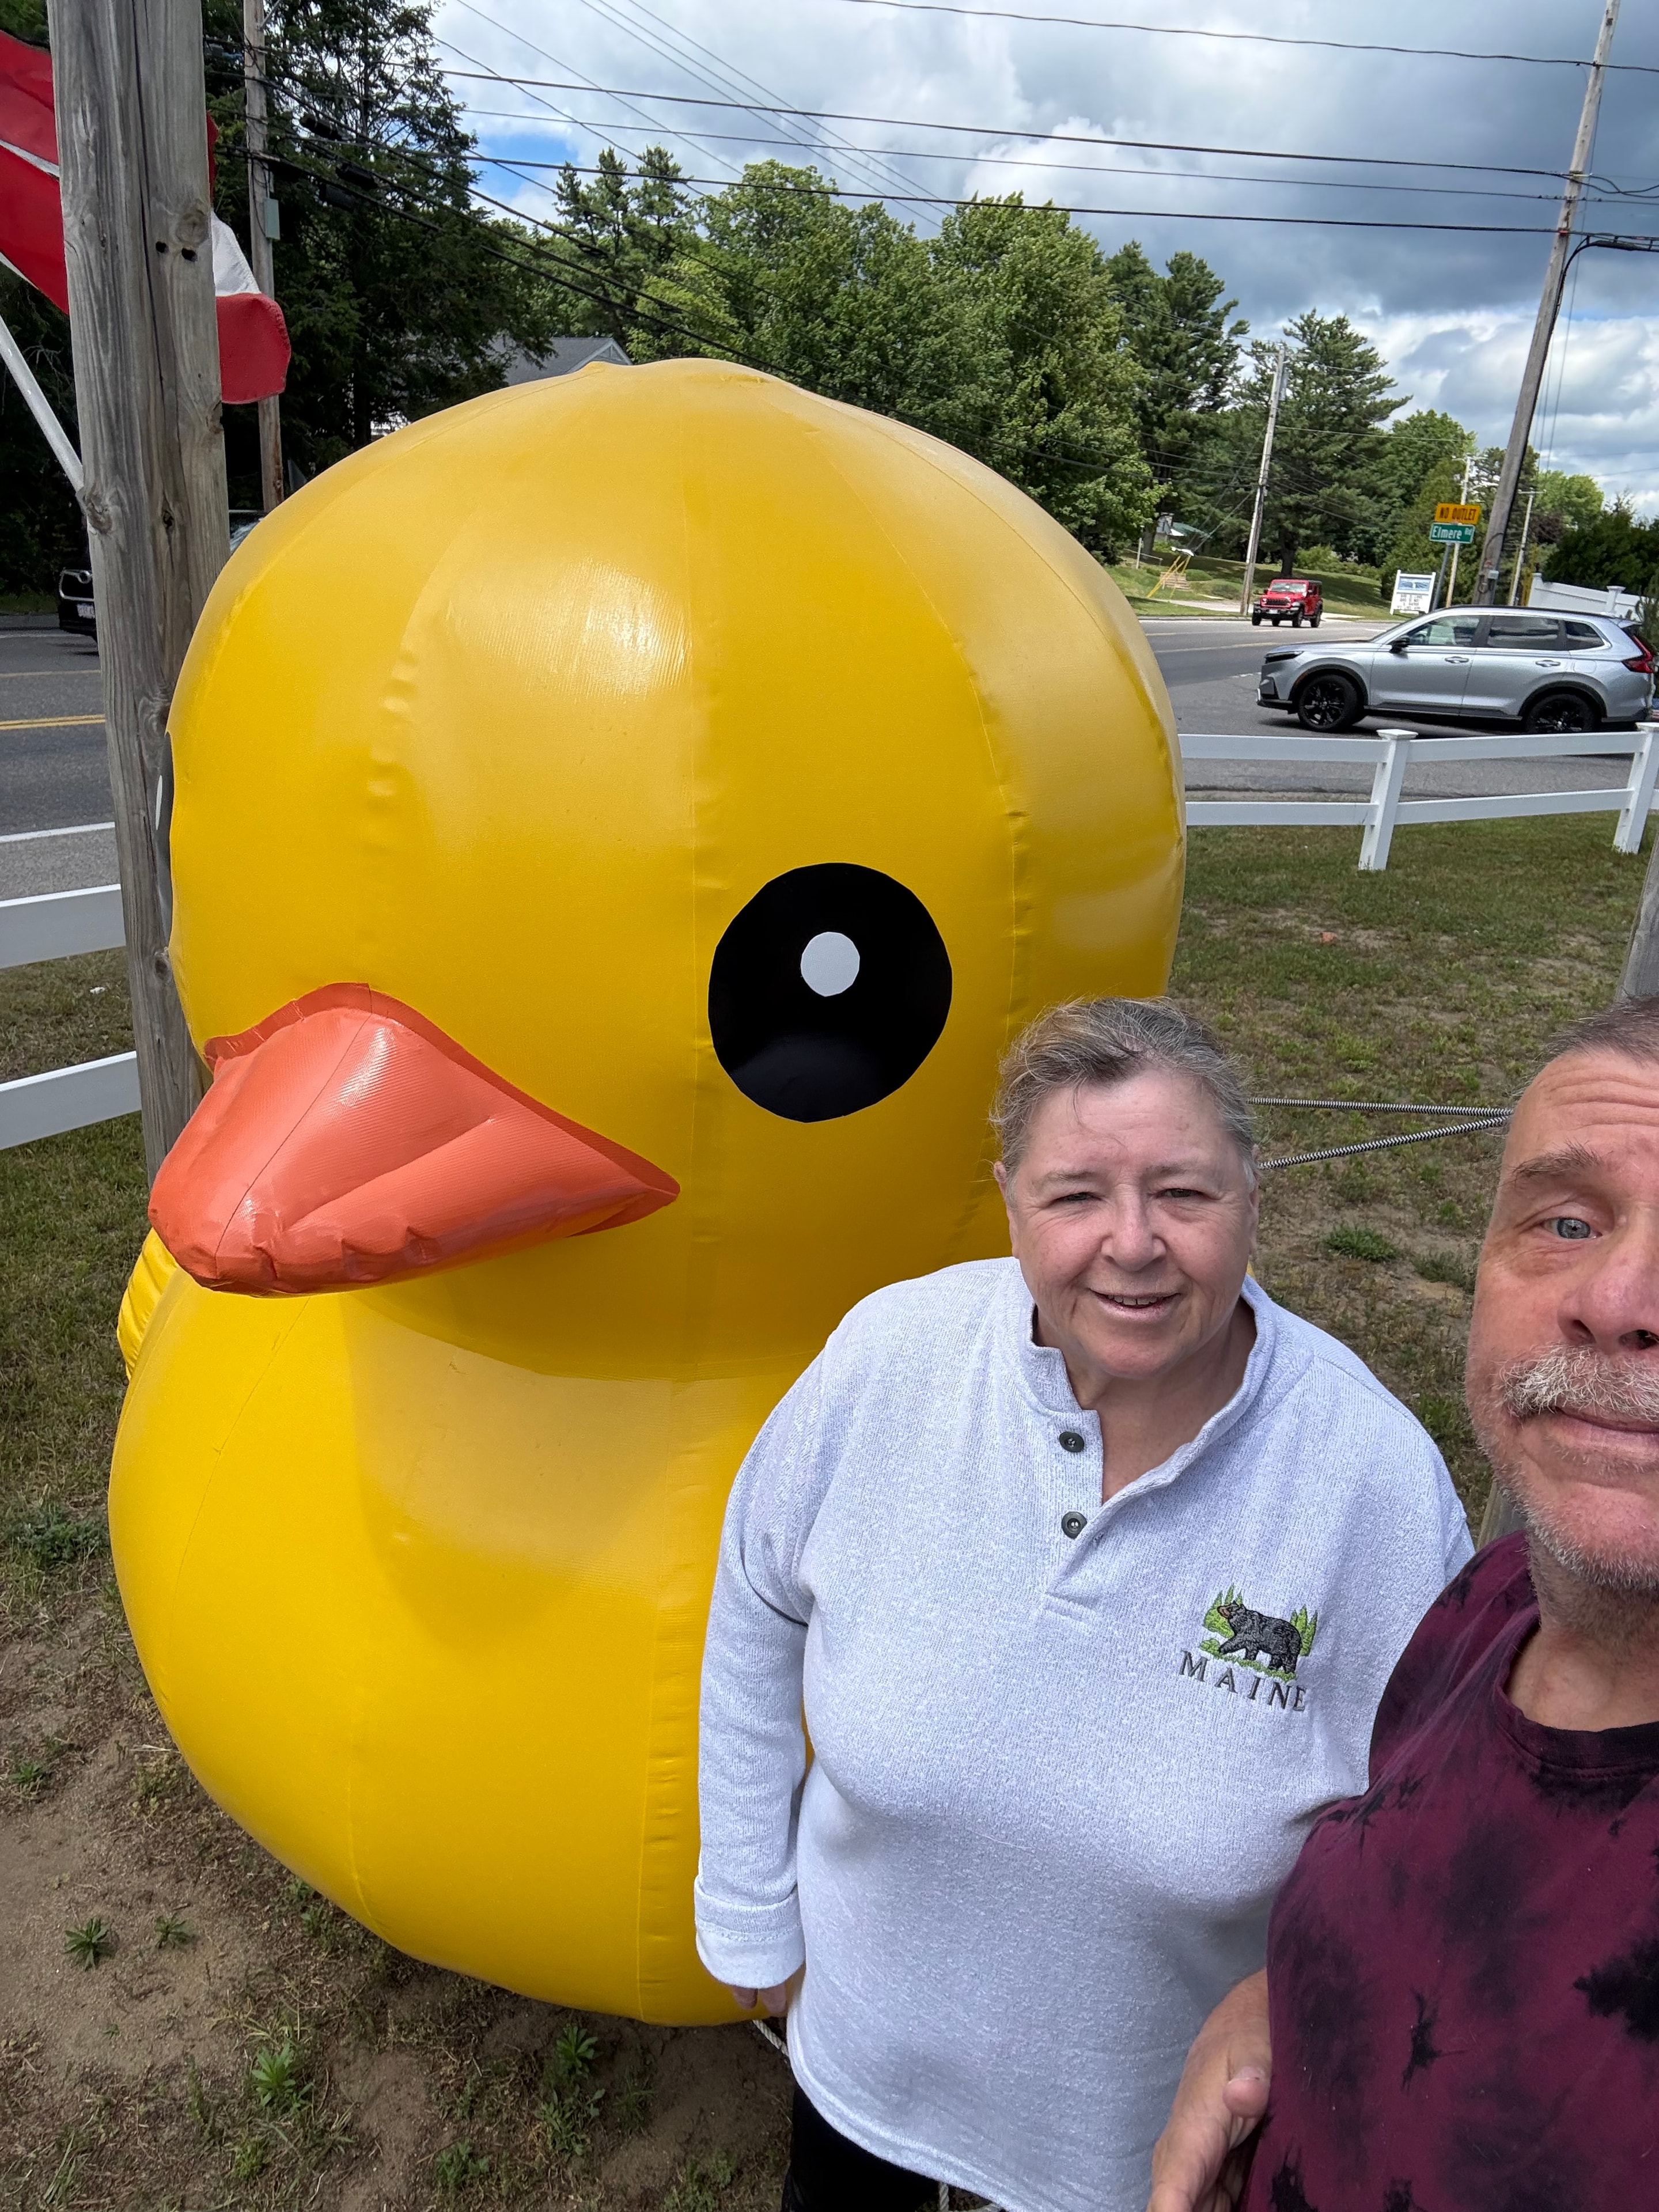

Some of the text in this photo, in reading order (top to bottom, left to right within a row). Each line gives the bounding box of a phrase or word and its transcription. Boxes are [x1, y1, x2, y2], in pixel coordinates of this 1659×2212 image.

[1440, 507, 1476, 521] NO OUTLET
[1431, 525, 1463, 540] Elmere
[1179, 1650, 1306, 1711] MAINE
